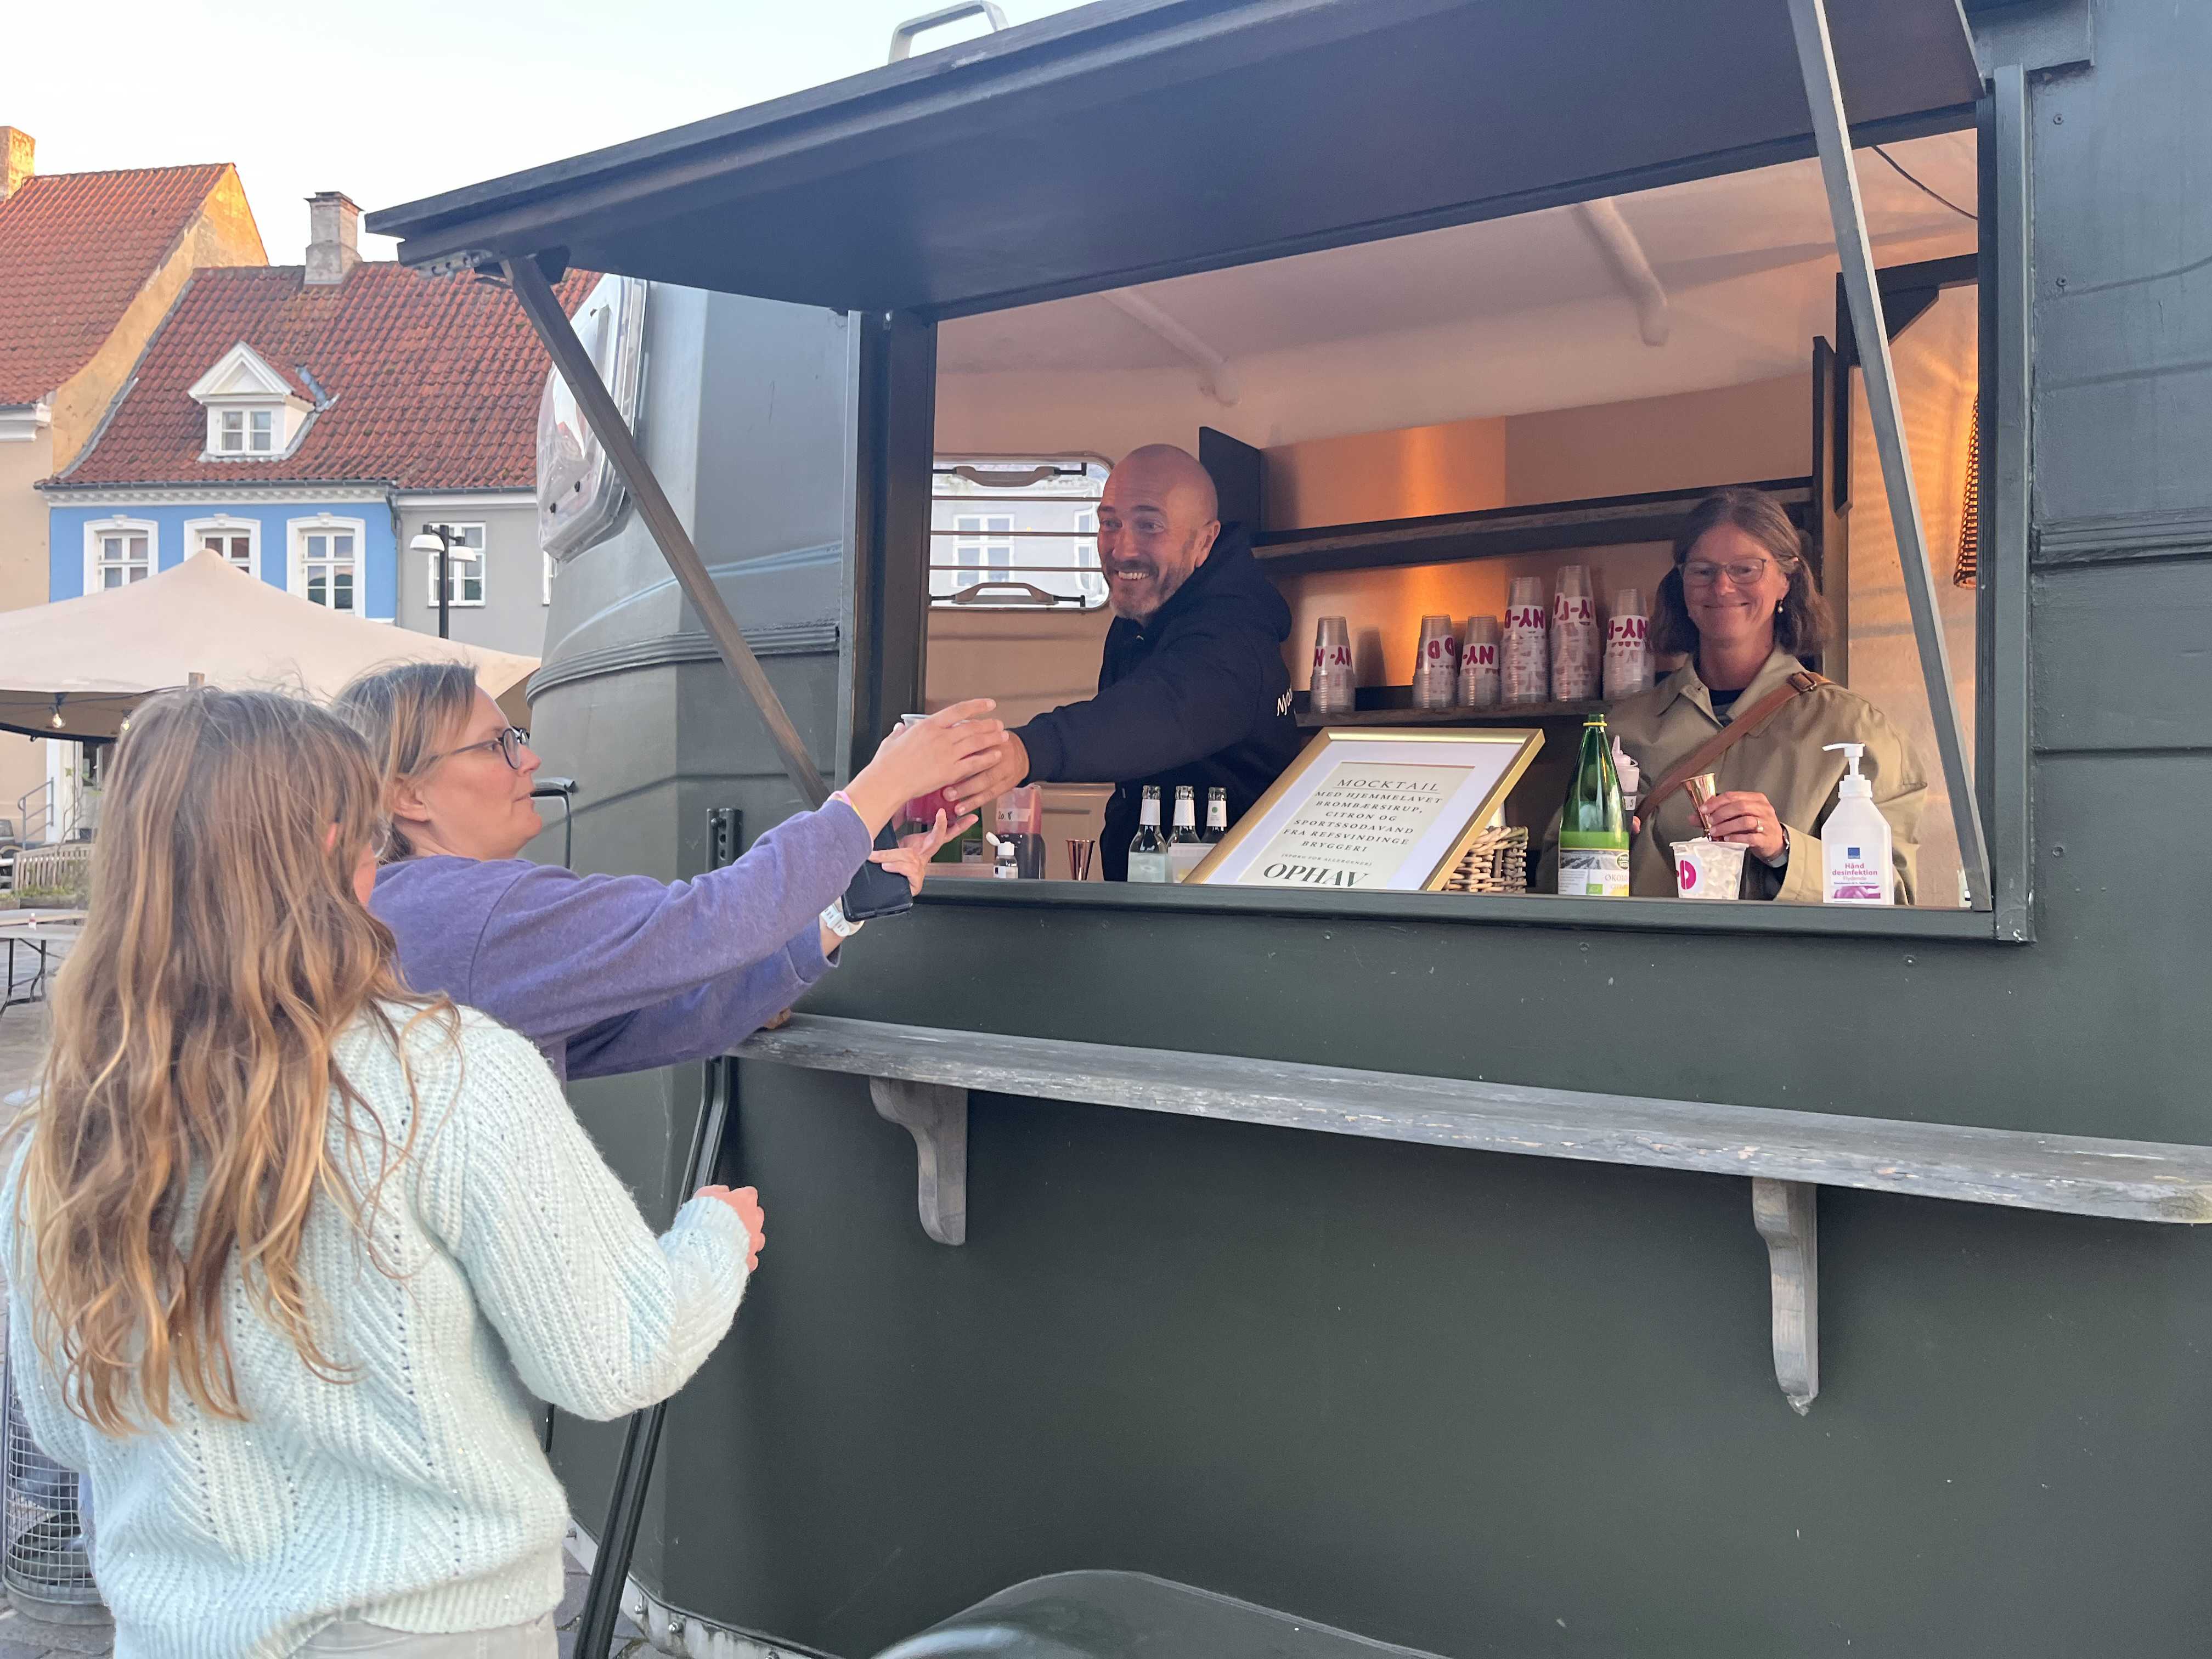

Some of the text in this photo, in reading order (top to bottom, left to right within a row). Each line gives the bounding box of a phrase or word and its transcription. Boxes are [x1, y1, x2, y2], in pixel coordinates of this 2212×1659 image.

[1337, 779, 1440, 791] MOCKTAIL
[1346, 792, 1443, 804] HJEMMELAVET
[1316, 801, 1423, 813] BROMBÆRSIRUP,
[1325, 811, 1374, 820] CITRON
[1294, 820, 1414, 834] SPORTSSODAVAND
[1311, 831, 1410, 845] REFSVINDINGE
[1301, 841, 1368, 851] BRYGGERI
[1263, 863, 1369, 887] OPHAV
